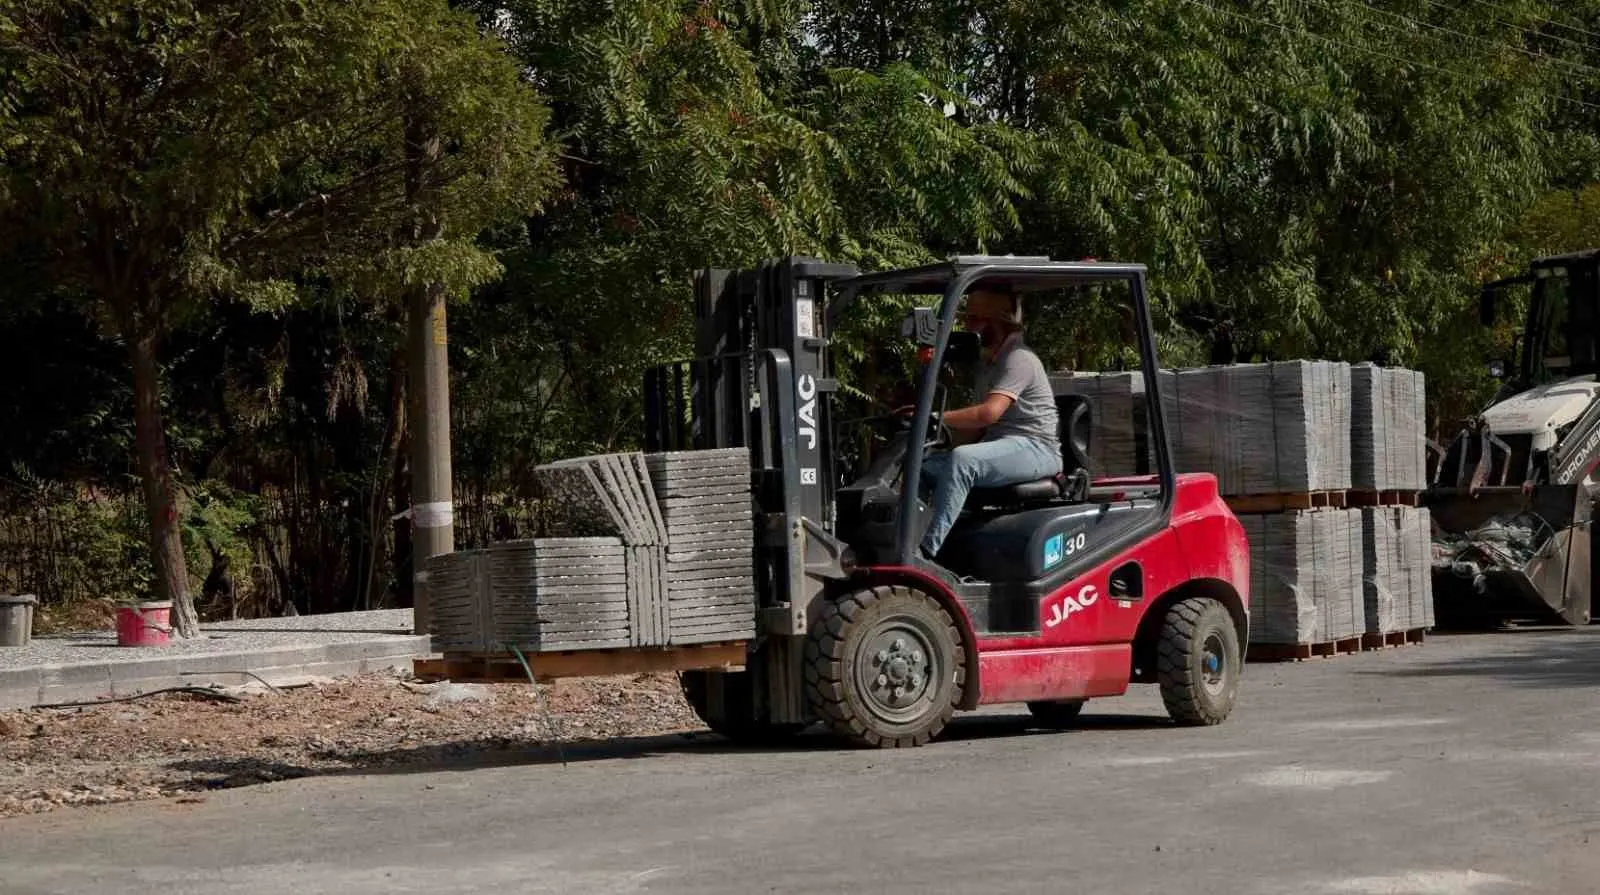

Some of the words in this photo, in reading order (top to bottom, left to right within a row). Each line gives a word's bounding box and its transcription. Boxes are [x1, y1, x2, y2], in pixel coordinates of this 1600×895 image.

[798, 374, 816, 450] JAC
[802, 471, 815, 481] CE
[1558, 428, 1600, 485] DROME
[1065, 532, 1085, 555] 30
[1045, 584, 1098, 628] JAC
